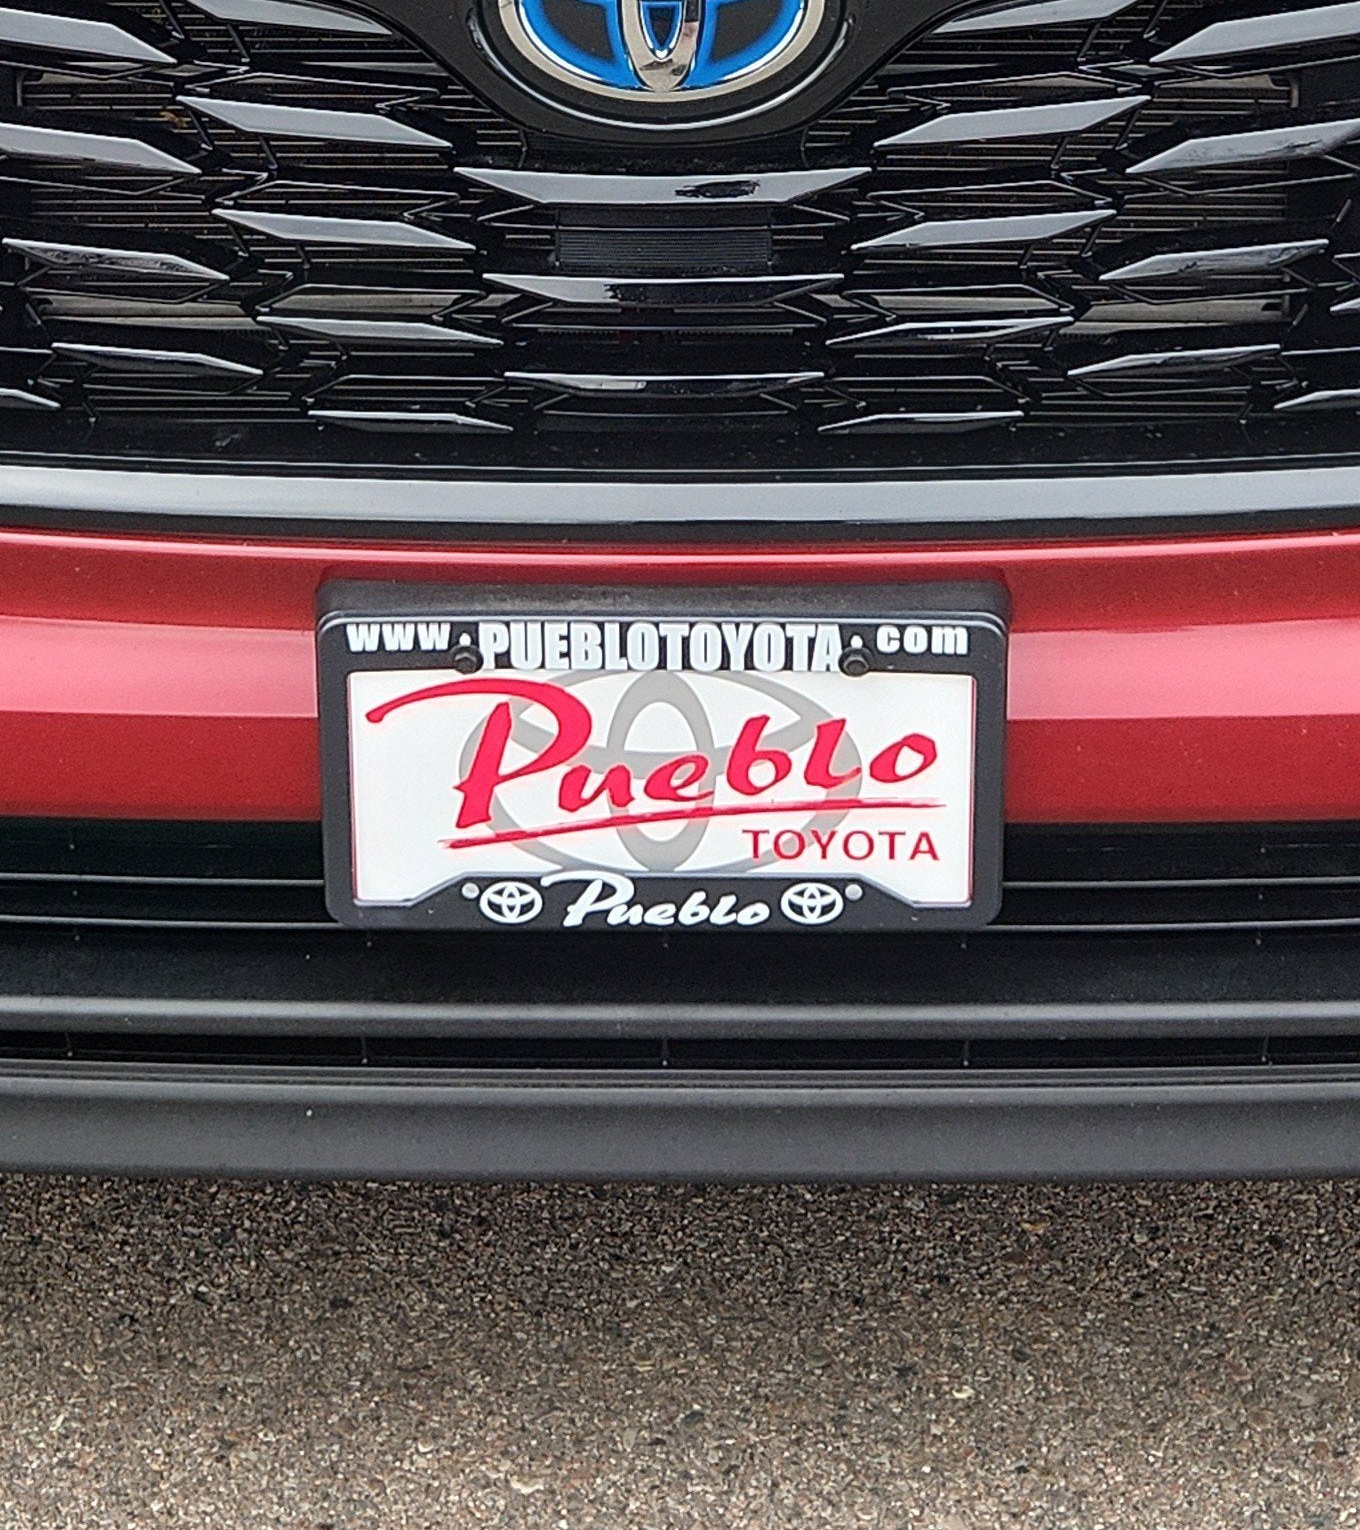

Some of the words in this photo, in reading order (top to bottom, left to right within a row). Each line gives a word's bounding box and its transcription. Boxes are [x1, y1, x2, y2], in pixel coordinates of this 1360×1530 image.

[366, 677, 939, 830] Pueblo
[743, 828, 941, 861] TOYOTA
[541, 869, 772, 929] Pueblo
